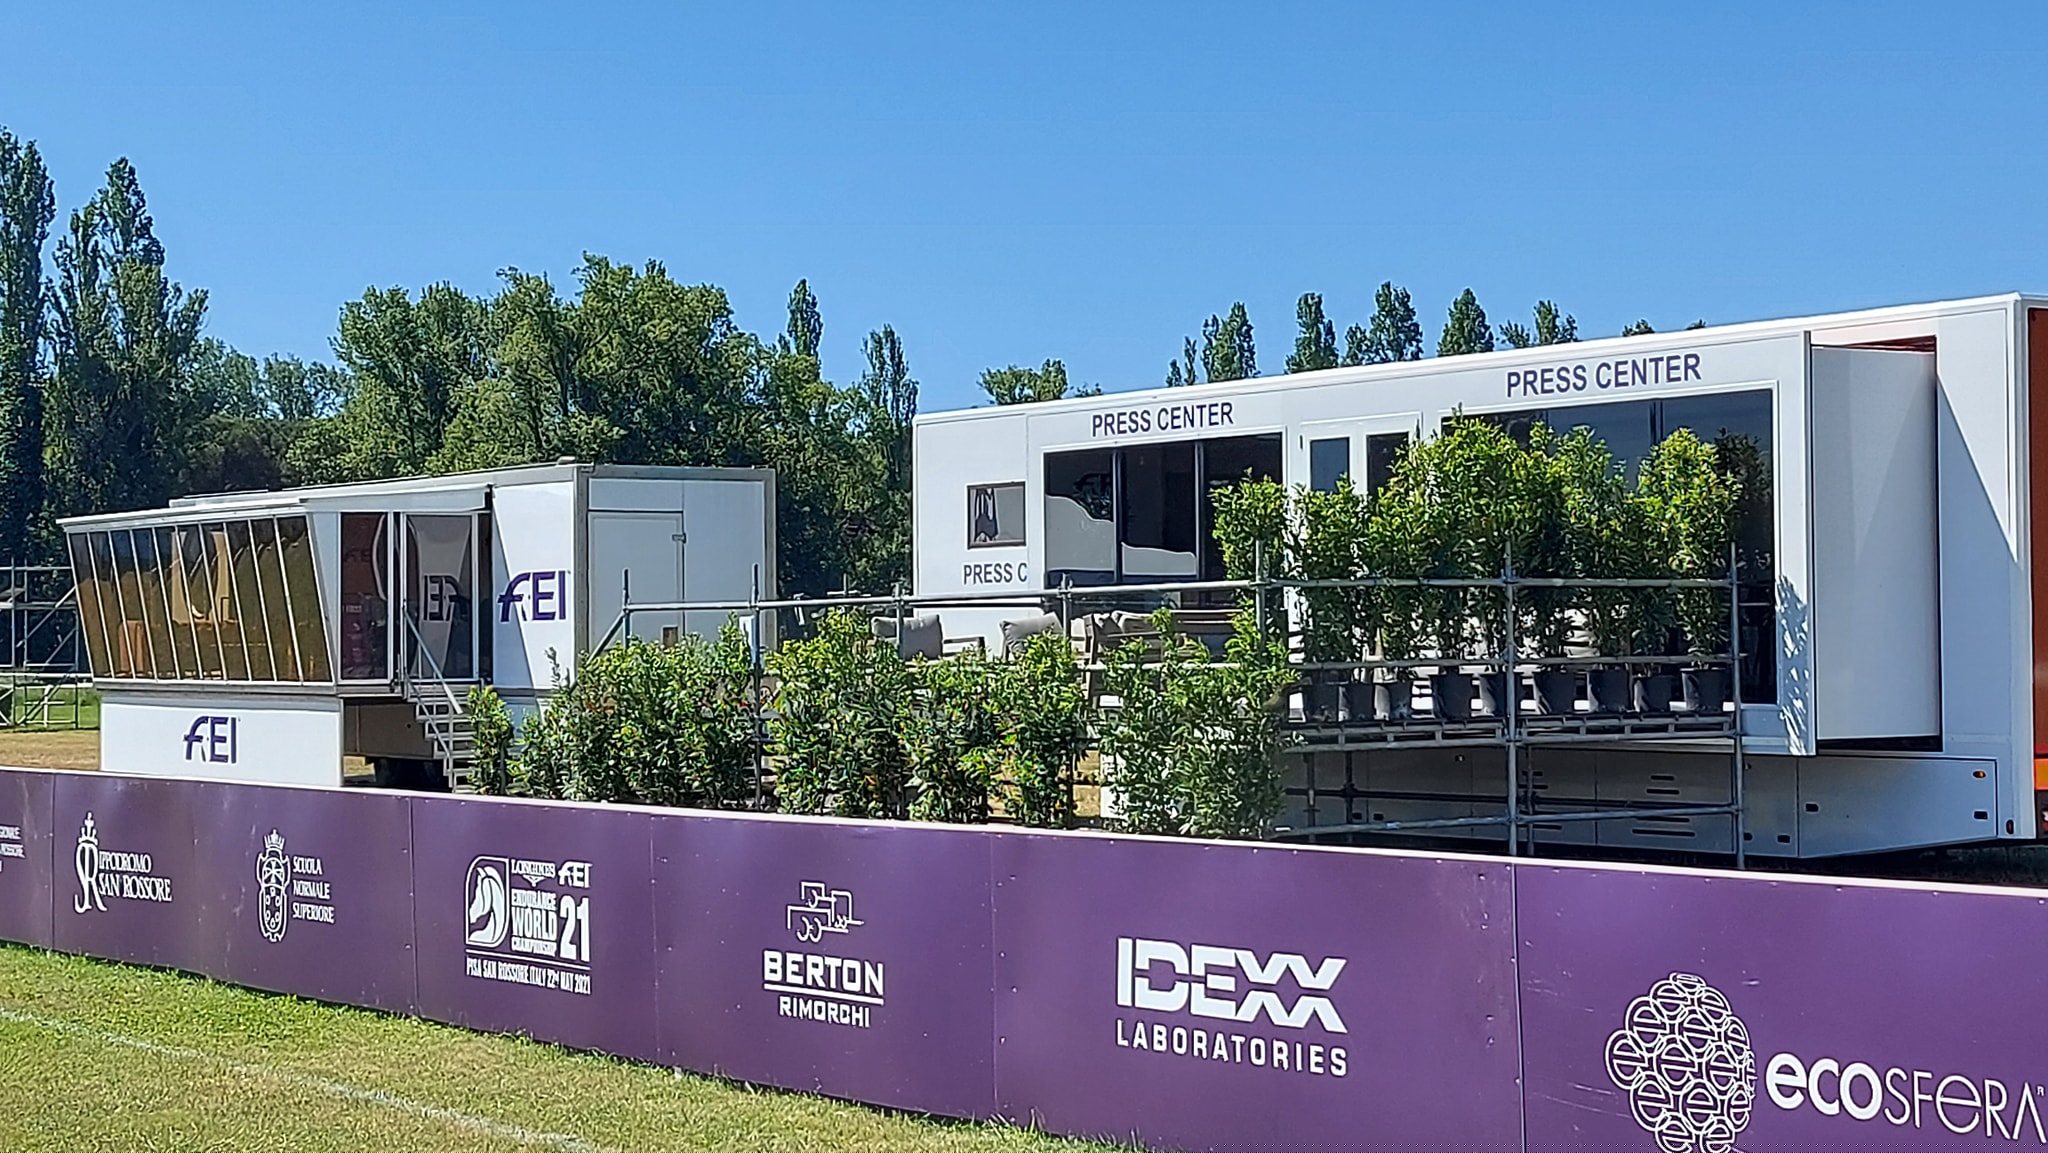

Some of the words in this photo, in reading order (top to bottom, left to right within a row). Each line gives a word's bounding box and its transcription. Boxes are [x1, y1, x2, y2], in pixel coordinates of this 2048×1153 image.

[1507, 365, 1587, 397] PRESS
[1595, 353, 1702, 389] CENTER
[1092, 409, 1151, 437] PRESS
[1157, 402, 1234, 431] CENTER
[963, 563, 1013, 585] PRESS
[498, 570, 566, 621] FEI
[183, 716, 237, 764] FEI
[293, 856, 323, 875] SCUOLA
[511, 859, 556, 878] LONGINES
[558, 861, 592, 888] FEI
[98, 872, 120, 896] SAN
[122, 875, 173, 901] ROSSORE
[293, 880, 331, 899] NORMALE
[511, 888, 557, 911] ENDURANCE
[292, 902, 335, 923] SUPERIORE
[511, 907, 557, 941] WORLD
[559, 895, 590, 962] 21
[511, 936, 557, 957] CHAMPIONSHIP
[466, 956, 482, 977] PISA
[483, 960, 497, 980] SAN
[498, 961, 529, 984] ROSSORE
[574, 973, 591, 994] 2021
[764, 950, 883, 996] BERTON
[1117, 937, 1348, 1034] IDEXX
[779, 996, 870, 1028] RIMORCHI
[1117, 1019, 1348, 1077] LABORATORIES
